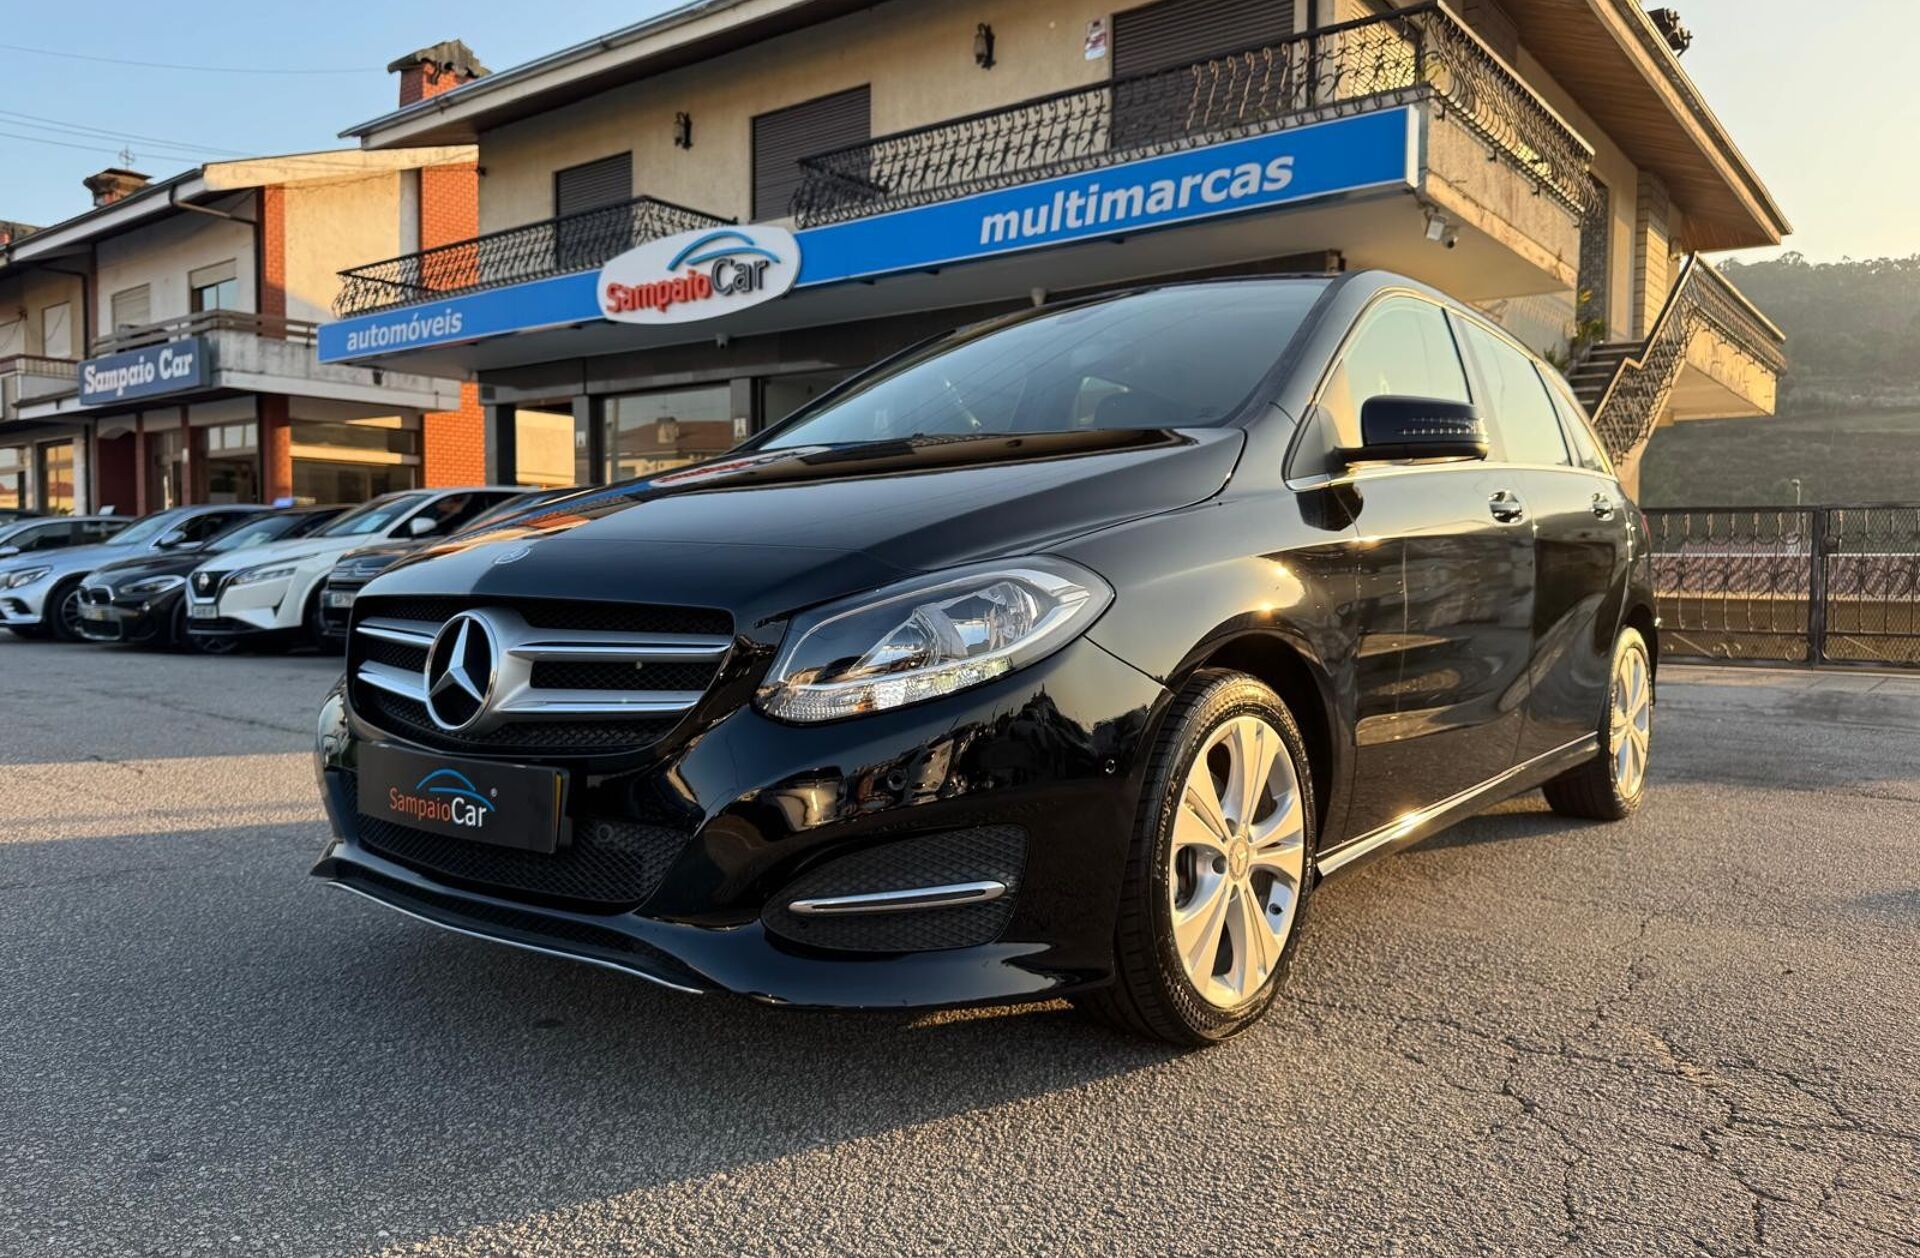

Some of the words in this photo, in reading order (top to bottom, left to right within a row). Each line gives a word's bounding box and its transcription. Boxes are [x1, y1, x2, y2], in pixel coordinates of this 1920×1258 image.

[979, 155, 1295, 245] multimarcas
[606, 257, 768, 313] SampaioCar
[347, 309, 463, 352] automóveis
[84, 357, 153, 396] Sampaio
[159, 348, 193, 377] Car
[389, 787, 487, 827] SampaioCar
